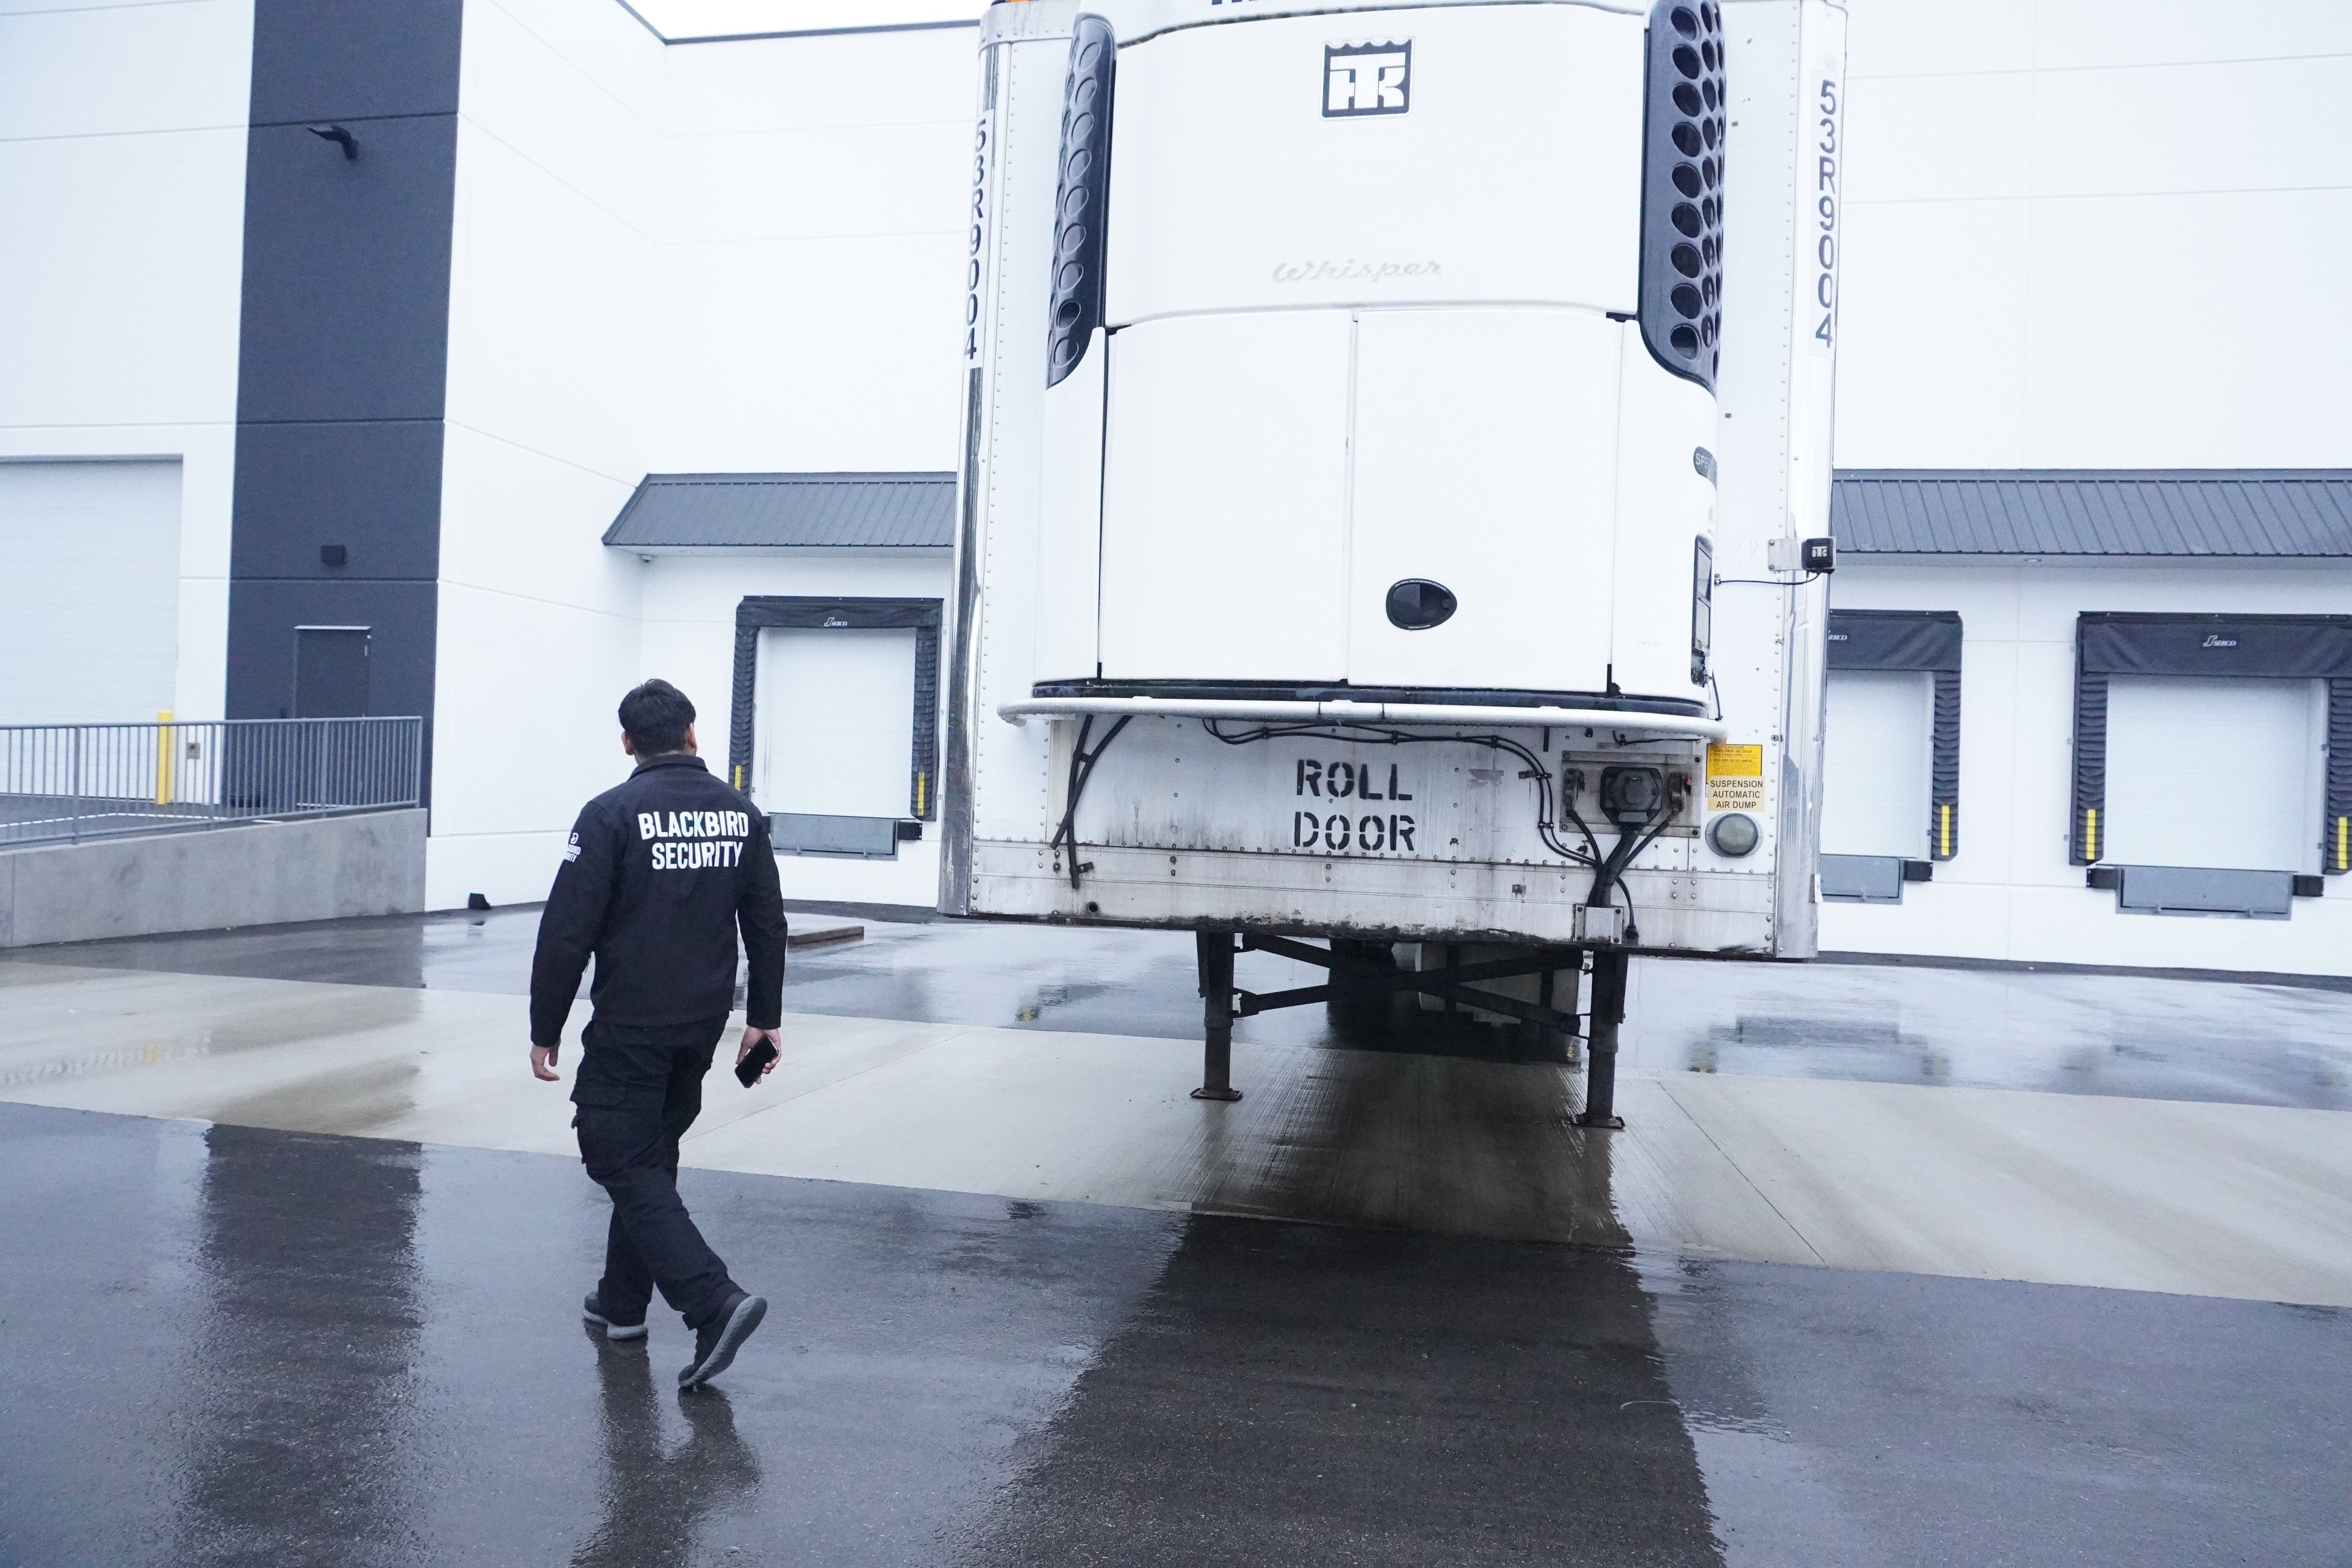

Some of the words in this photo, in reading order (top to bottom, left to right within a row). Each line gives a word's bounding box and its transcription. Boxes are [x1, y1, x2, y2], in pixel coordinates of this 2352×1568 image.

[1815, 79, 1836, 348] 53R9004
[1272, 258, 1443, 283] Whisper
[1296, 759, 1413, 800] ROLL
[637, 811, 749, 840] BLACKBIRD
[1294, 811, 1415, 851] DOOR
[652, 841, 743, 870] SECURITY
